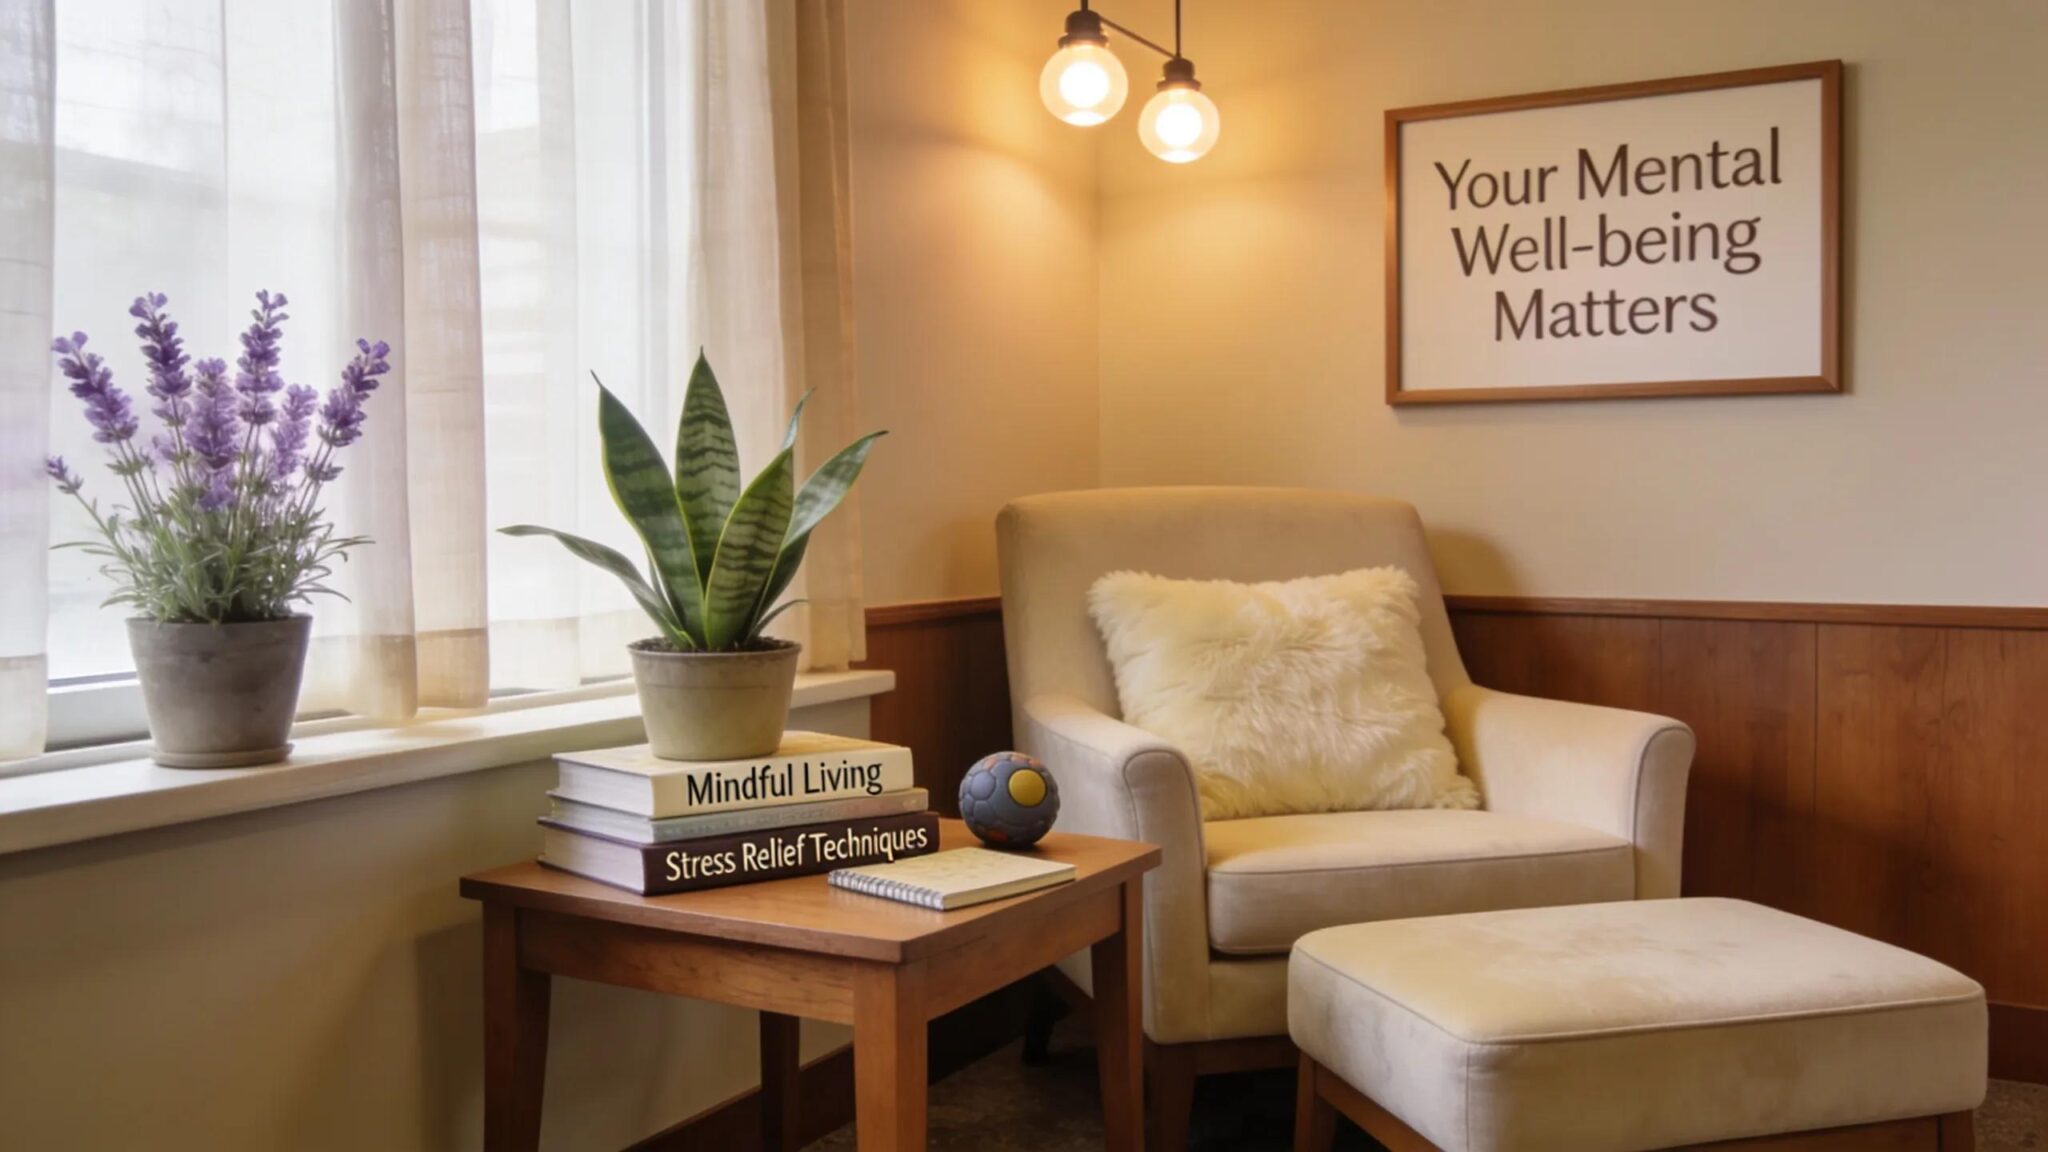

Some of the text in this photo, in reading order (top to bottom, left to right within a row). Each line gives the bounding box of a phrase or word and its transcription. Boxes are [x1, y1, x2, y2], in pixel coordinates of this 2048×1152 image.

[1433, 126, 1783, 211] Your Mental
[1450, 211, 1763, 277] Well-being
[1494, 288, 1719, 342] Matters
[686, 759, 883, 807] Mindful Living
[665, 827, 928, 882] Stress Relief Techniques
